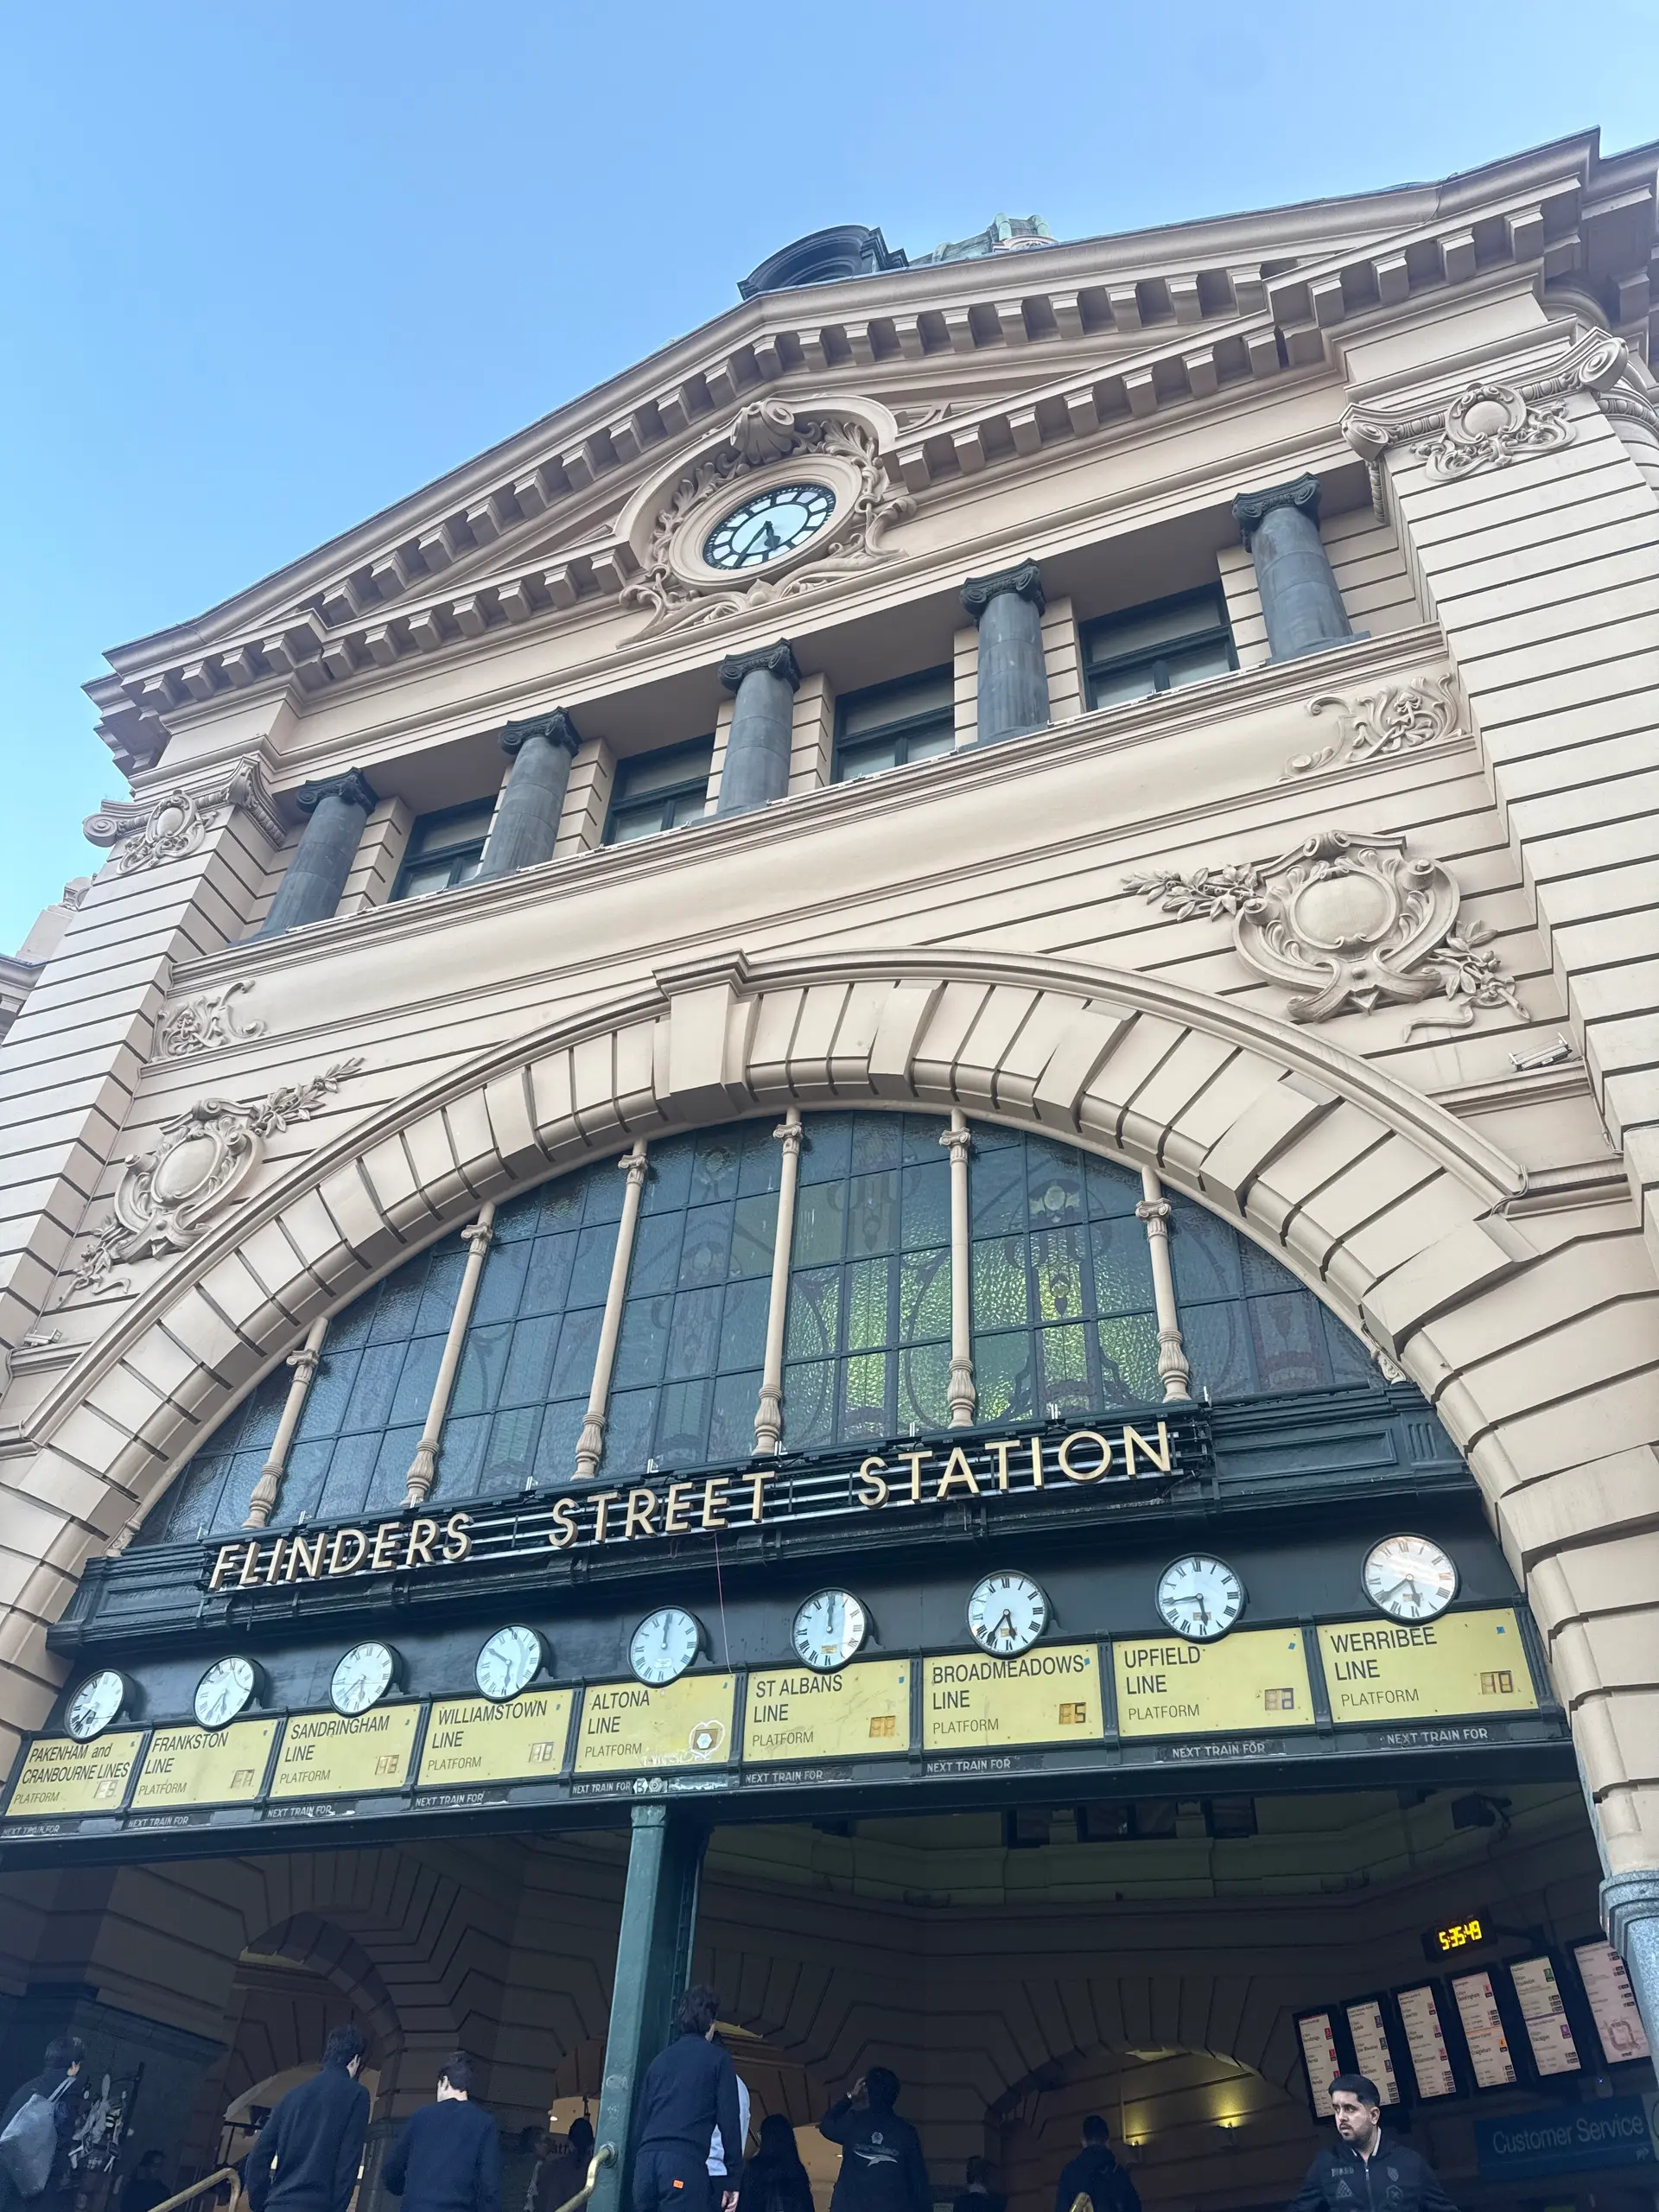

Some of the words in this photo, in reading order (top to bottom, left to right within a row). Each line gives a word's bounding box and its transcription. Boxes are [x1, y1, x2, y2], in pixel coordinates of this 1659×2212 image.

[209, 1513, 474, 1591] FLINDERS
[549, 1471, 776, 1548] STREET
[858, 1421, 1172, 1509] STATION
[1330, 1626, 1437, 1654] WERRIBEE
[1124, 1645, 1201, 1669] UPFIELD
[932, 1655, 1084, 1684] BROADMEADOWS
[1334, 1659, 1380, 1681] LINE
[756, 1680, 776, 1699] ST
[779, 1675, 842, 1696] ALBANS
[1126, 1675, 1167, 1694] LINE
[591, 1689, 650, 1710] ALTONA
[933, 1689, 970, 1710] LINE
[1341, 1688, 1420, 1707] PLATFORM
[439, 1700, 547, 1725] WILLIAMSTOWN
[753, 1703, 789, 1723] LINE
[1128, 1704, 1199, 1720] PLATFORM
[290, 1715, 390, 1739] SANDRINGHAM
[588, 1716, 620, 1734] LINE
[933, 1719, 999, 1734] PLATFORM
[151, 1732, 229, 1752] FRANKSTON
[432, 1731, 464, 1749] LINE
[753, 1732, 814, 1746] PLATFORM
[1387, 1732, 1418, 1745] NEXT
[1423, 1729, 1459, 1742] TRAIN
[1465, 1728, 1488, 1739] FOR
[29, 1745, 89, 1763] PAKENHAM
[92, 1743, 113, 1758] and
[284, 1745, 315, 1763] LINE
[584, 1743, 642, 1758] PLATFORM
[1173, 1747, 1199, 1759] NEXT
[1205, 1744, 1239, 1757] TRAIN
[1243, 1742, 1265, 1754] FOR
[145, 1758, 175, 1775] LINE
[428, 1757, 481, 1770] PLATFORM
[926, 1763, 953, 1773] NEXT
[956, 1760, 988, 1771] TRAIN
[990, 1758, 1011, 1769] FOR
[22, 1764, 97, 1784] CRANBOURNE
[97, 1762, 130, 1779] LINES
[280, 1770, 330, 1783] PLATFORM
[746, 1773, 769, 1783] NEXT
[772, 1771, 802, 1783] TRAIN
[804, 1770, 823, 1780] FOR
[138, 1783, 187, 1796] PLATFORM
[572, 1785, 589, 1794] NEXT
[591, 1783, 613, 1793] TRAIN
[616, 1781, 632, 1791] FOR
[14, 1792, 60, 1804] PLATFORM
[415, 1796, 437, 1807] NEXT
[439, 1794, 464, 1805] TRAIN
[467, 1793, 484, 1802] FOR
[267, 1808, 288, 1818] NEXT
[290, 1806, 314, 1816] TRAIN
[315, 1805, 332, 1815] FOR
[3, 1827, 20, 1835] NEXT
[23, 1826, 43, 1834] TRAIN
[45, 1825, 60, 1834] FOR
[128, 1818, 148, 1827] NEXT
[150, 1817, 172, 1827] TRAIN
[174, 1816, 188, 1825] FOR
[1439, 1920, 1482, 1950] 5:35:49
[1492, 2125, 1573, 2153] Customer
[1576, 2113, 1644, 2142] Service
